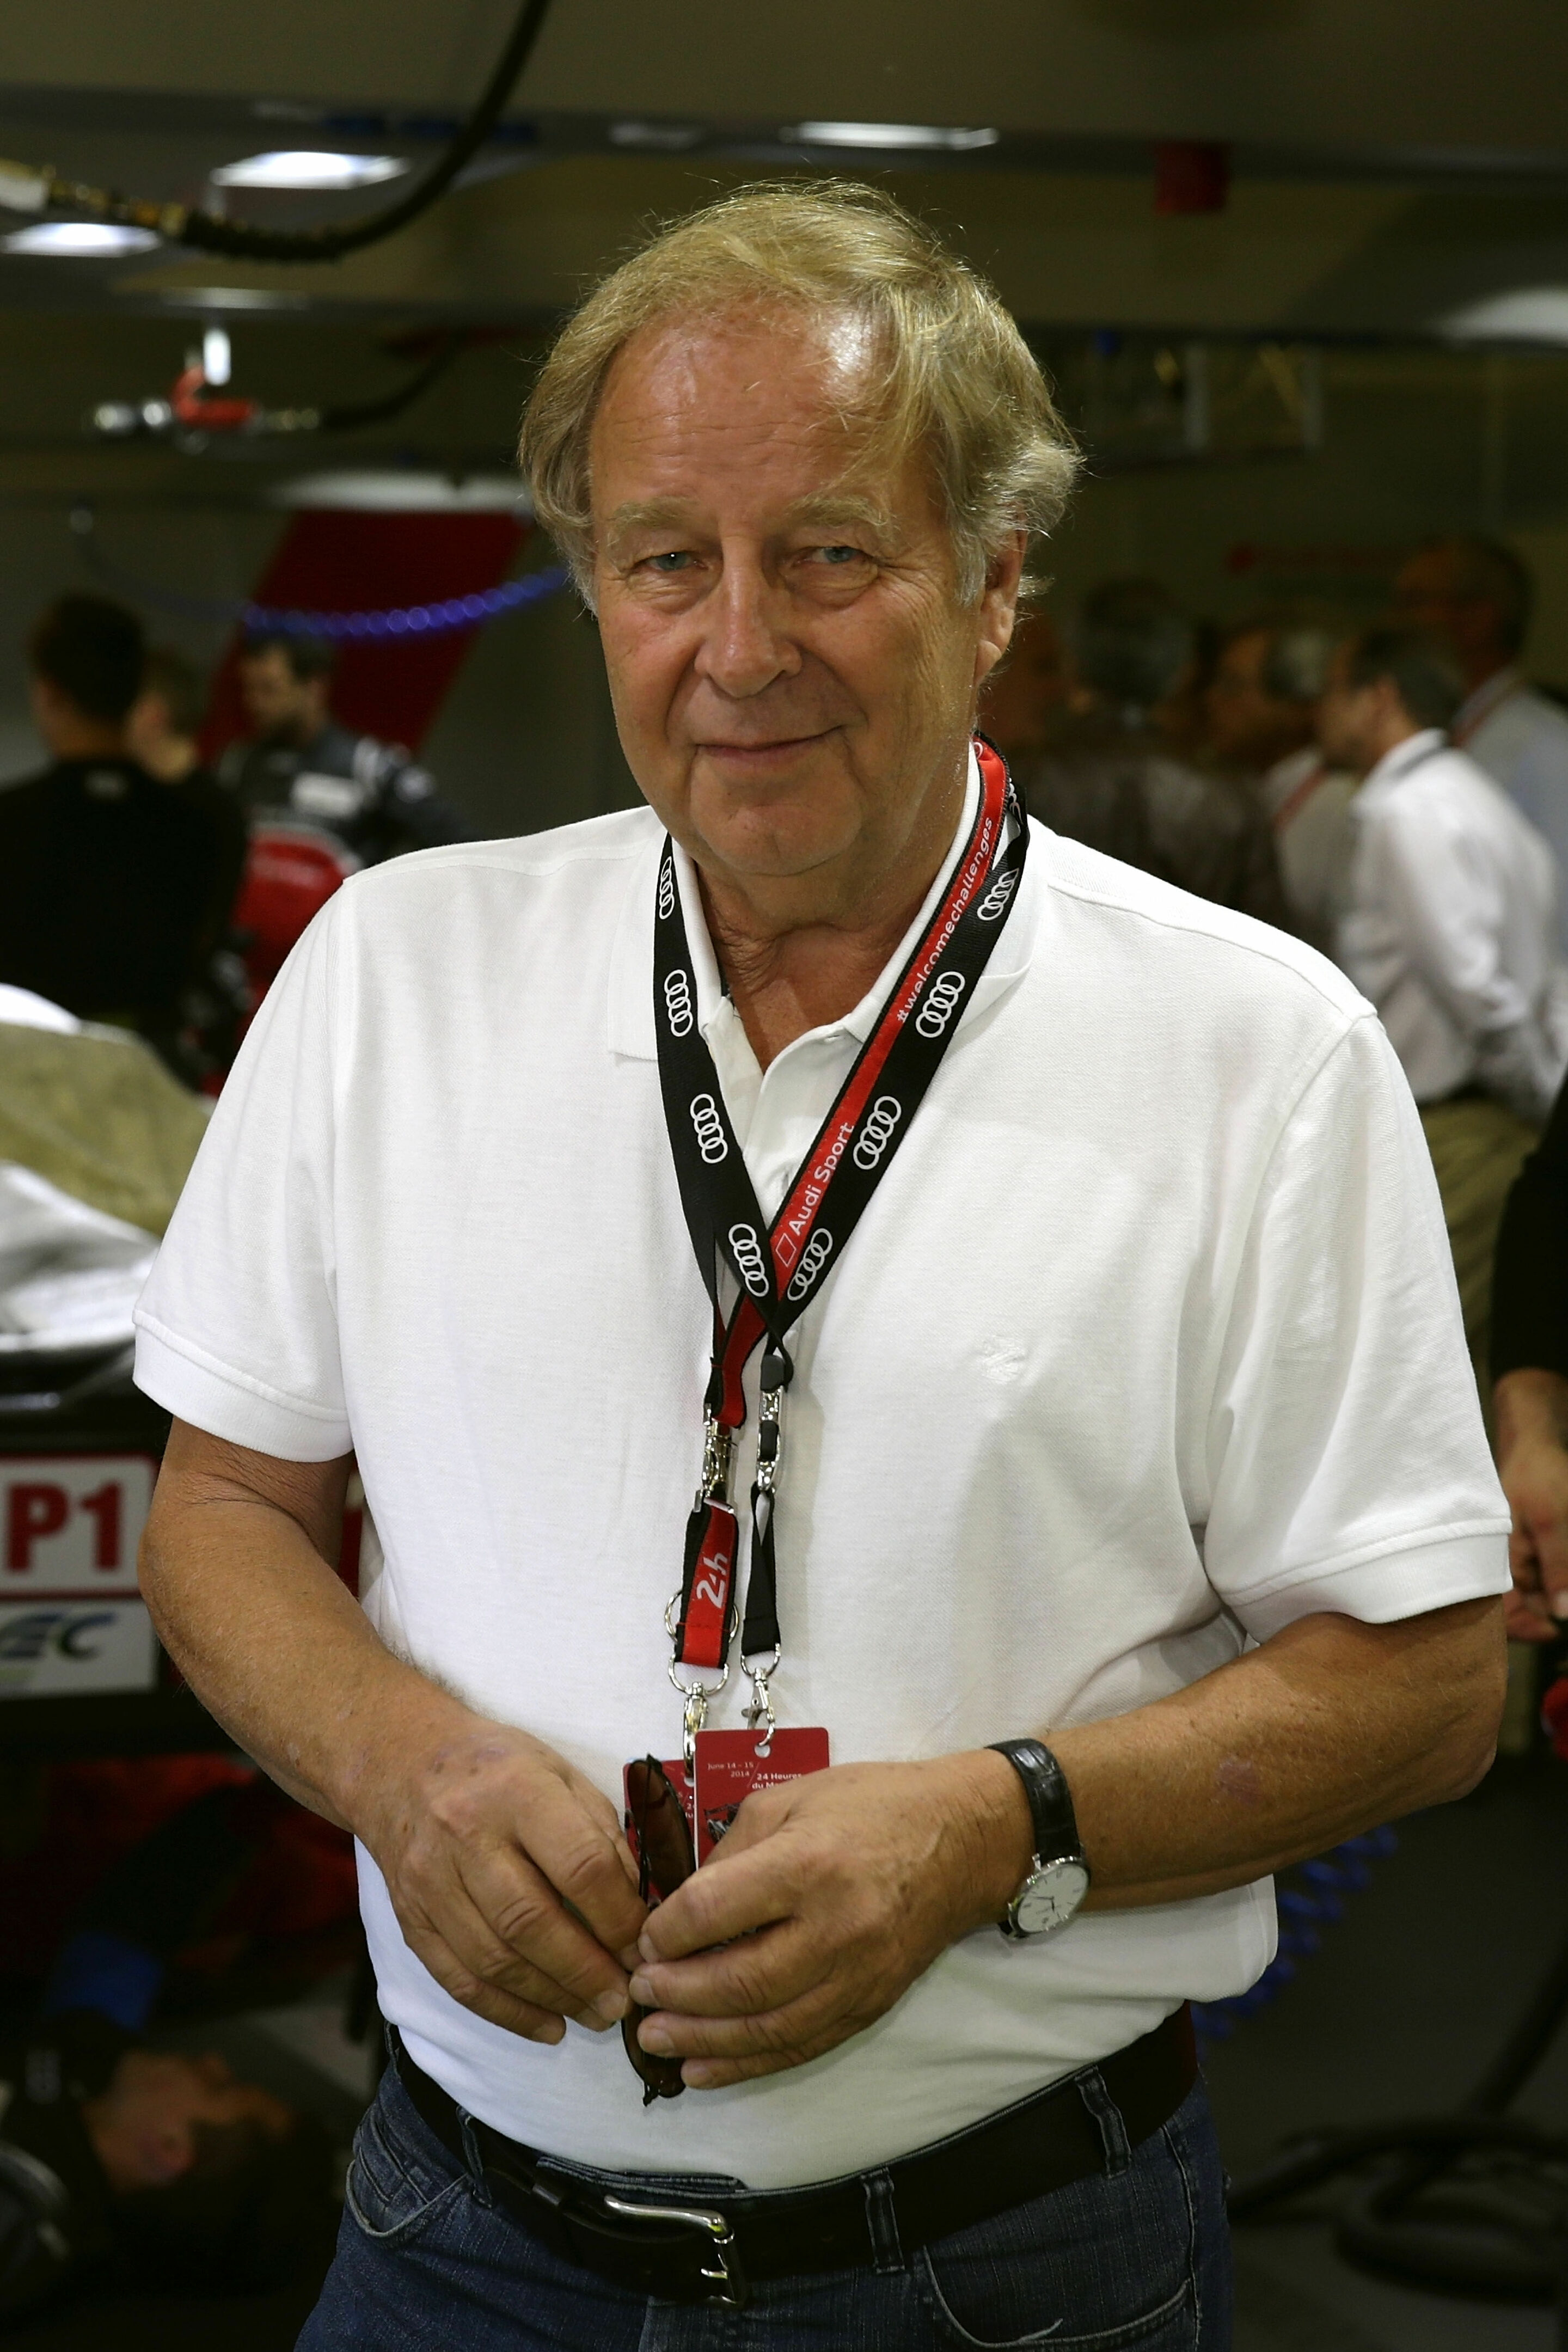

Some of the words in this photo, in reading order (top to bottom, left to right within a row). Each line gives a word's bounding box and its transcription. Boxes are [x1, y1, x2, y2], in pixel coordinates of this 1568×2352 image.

[896, 817, 993, 1024] #welcomechallenges
[788, 1184, 822, 1236] Audi
[813, 1122, 855, 1183] Sport
[757, 1773, 768, 1781] 24
